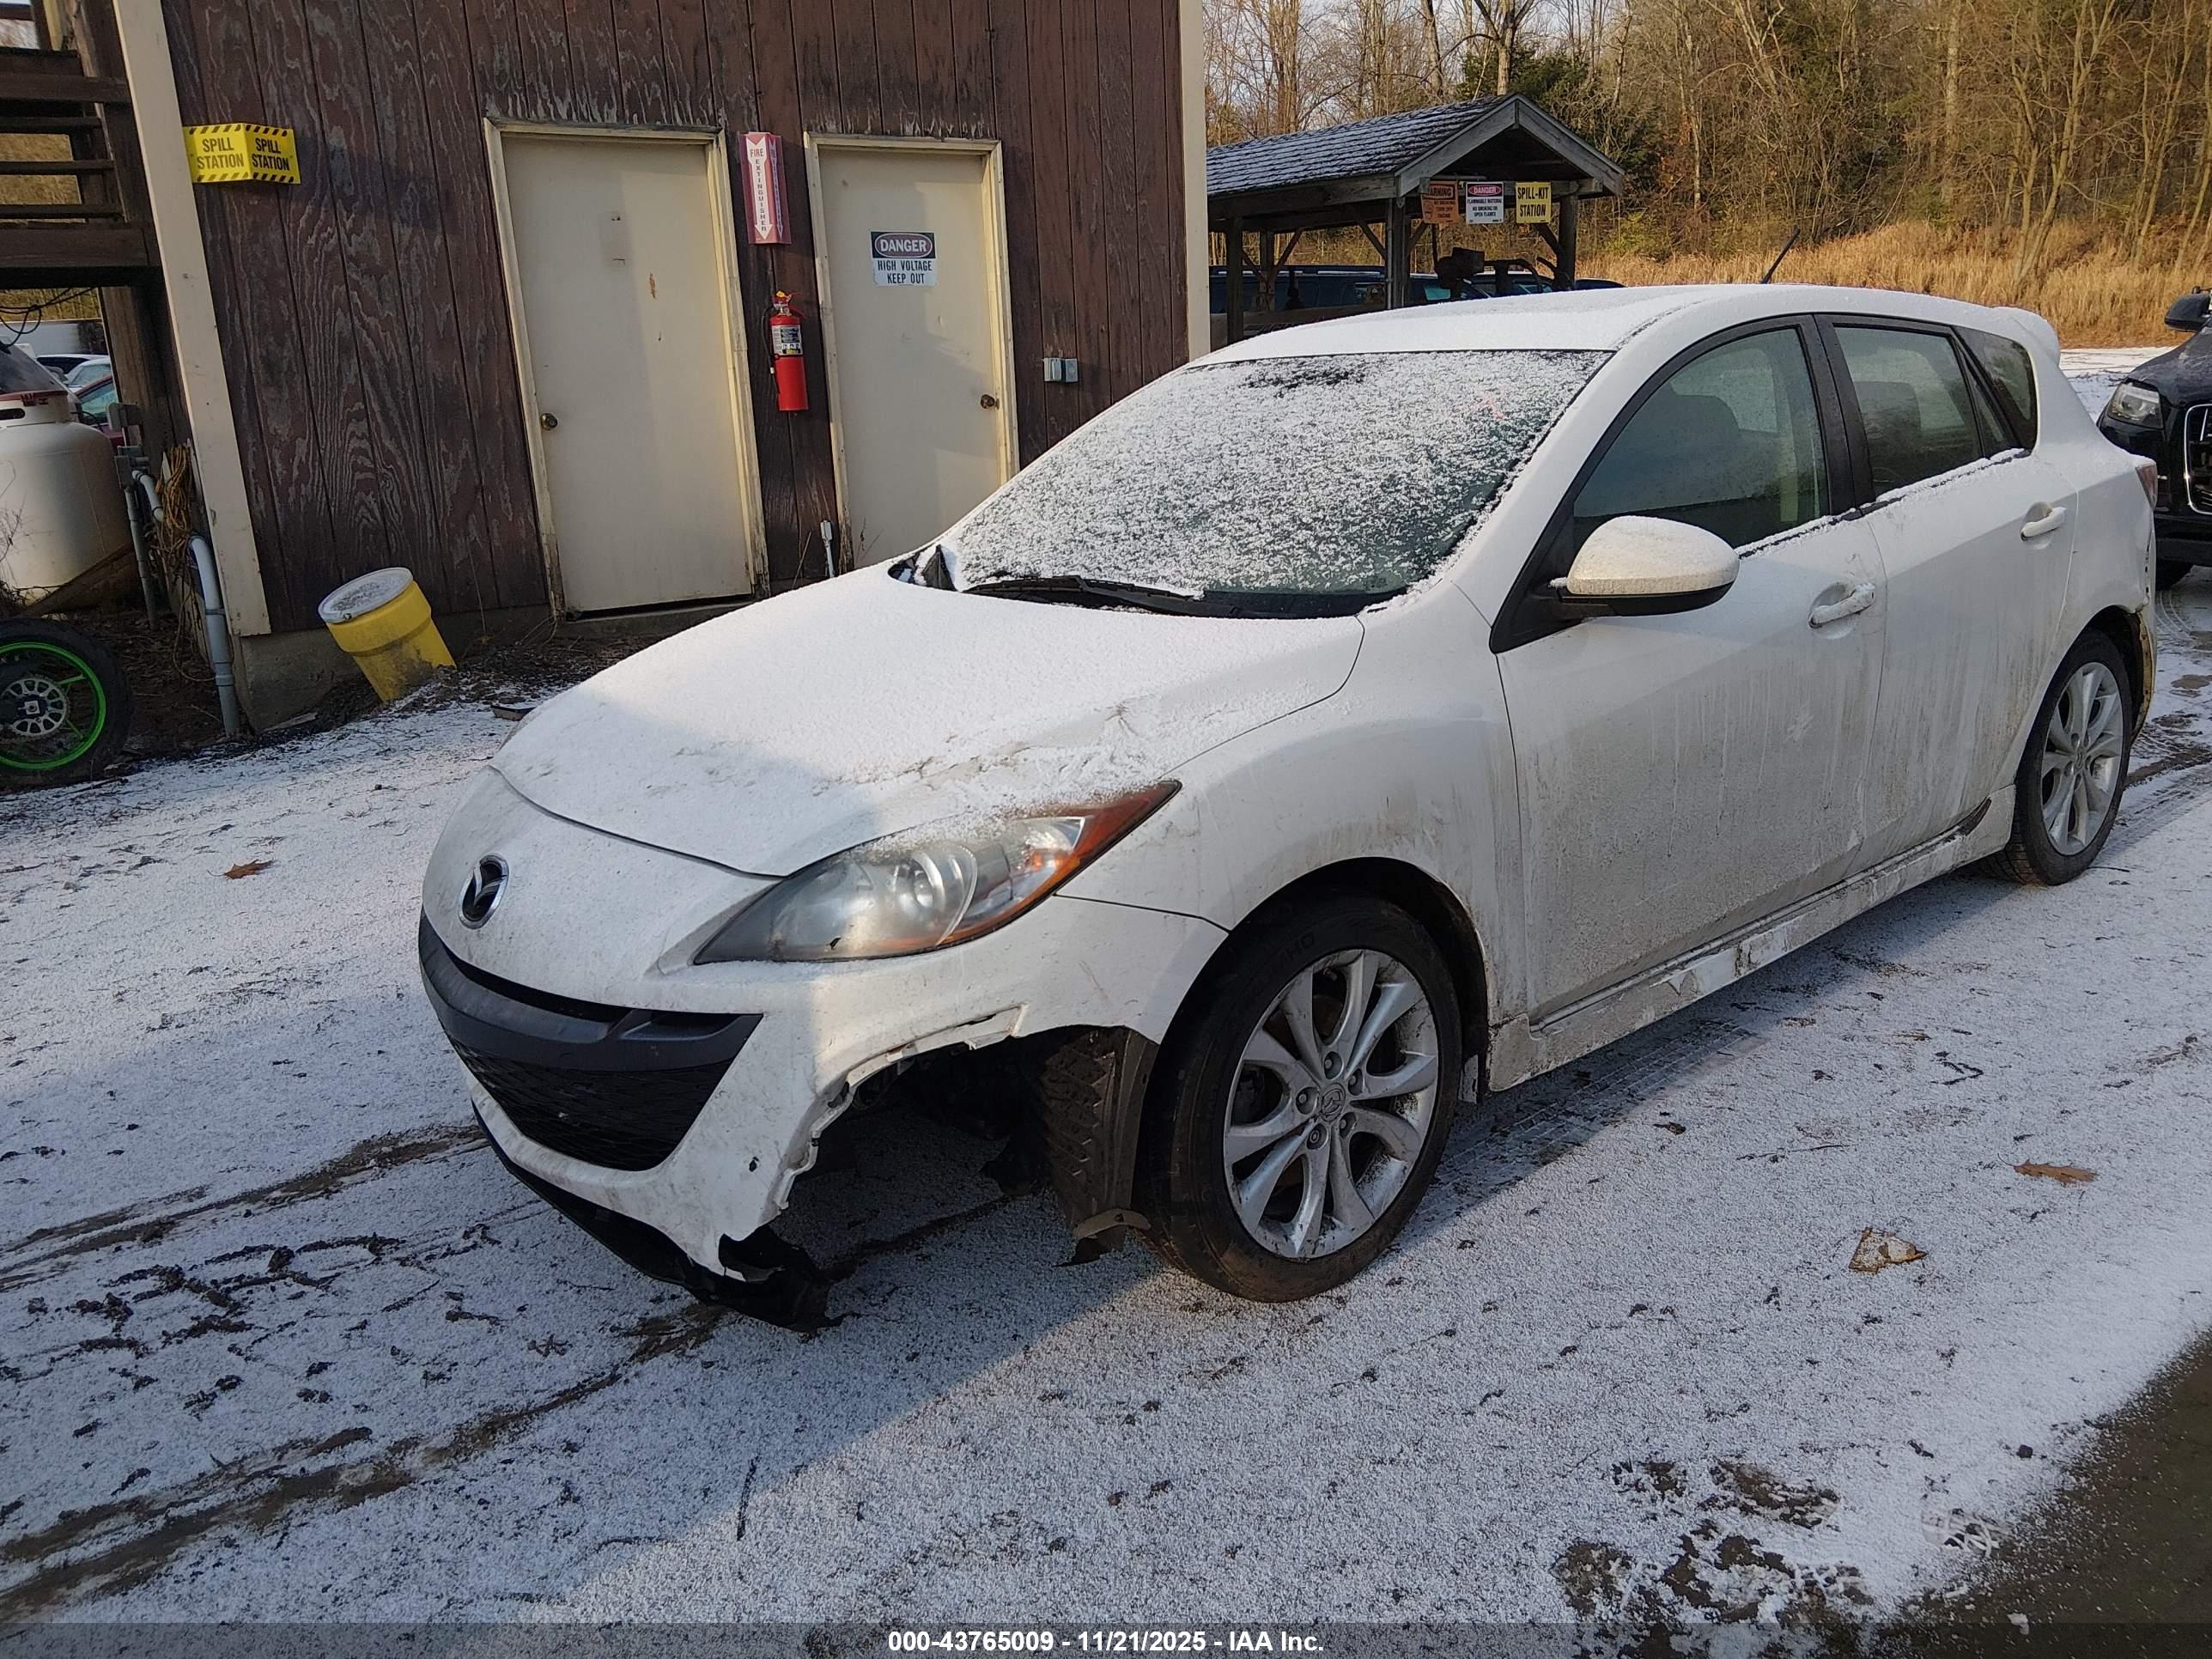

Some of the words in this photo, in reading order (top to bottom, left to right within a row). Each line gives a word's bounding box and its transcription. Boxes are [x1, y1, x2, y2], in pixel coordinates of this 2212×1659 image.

[202, 137, 234, 153] SPILL
[255, 137, 282, 154] SPILL
[750, 148, 764, 158] FIRE
[197, 153, 245, 170] STATION
[252, 153, 290, 171] STATION
[755, 159, 767, 232] EXTINGUISHER
[1429, 186, 1451, 197] ARNING
[1517, 186, 1549, 199] SPILL-KIT
[1520, 204, 1547, 216] STATION
[880, 239, 927, 252] DANGER
[877, 260, 896, 271] HIGH
[900, 260, 933, 271] VOLTAGE
[887, 273, 906, 284] KEEP
[910, 273, 925, 284] OUT
